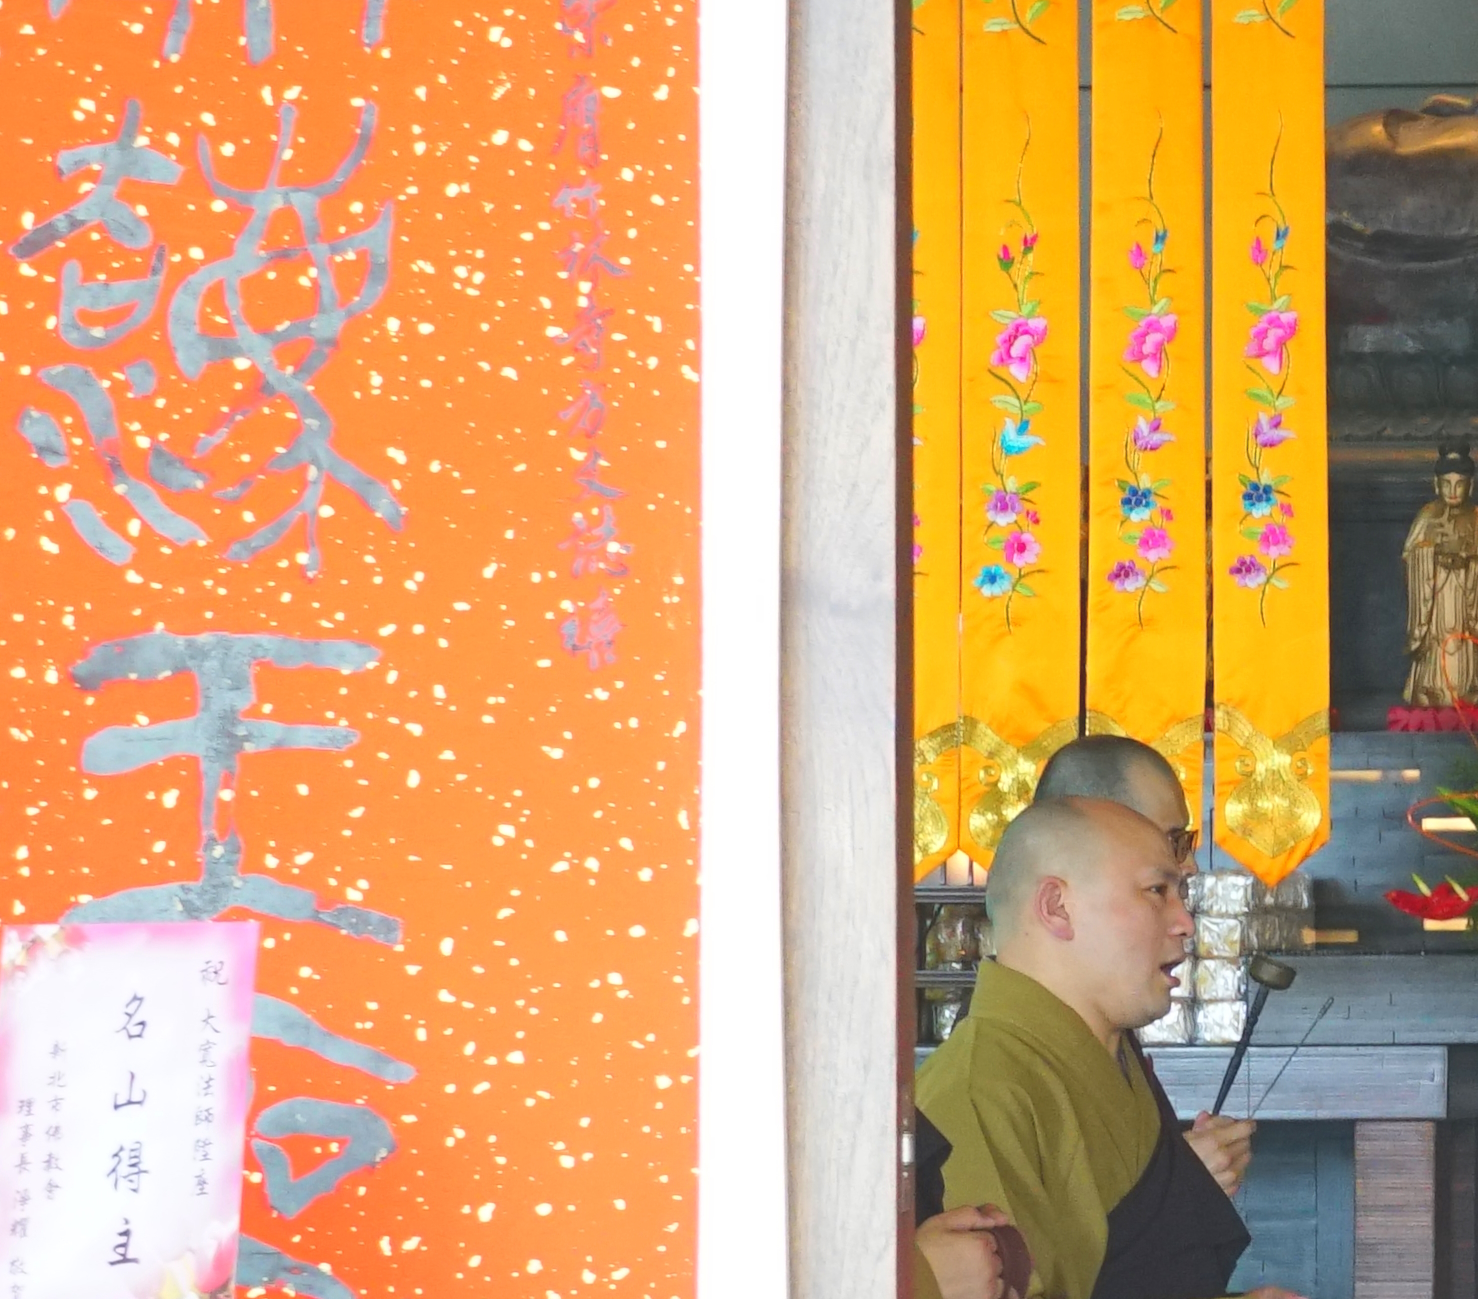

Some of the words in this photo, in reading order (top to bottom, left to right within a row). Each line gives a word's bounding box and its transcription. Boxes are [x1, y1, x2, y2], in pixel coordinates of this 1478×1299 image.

[200, 960, 228, 985] 祝
[14, 1097, 35, 1174] 理事長
[106, 993, 149, 1267] 名山得主
